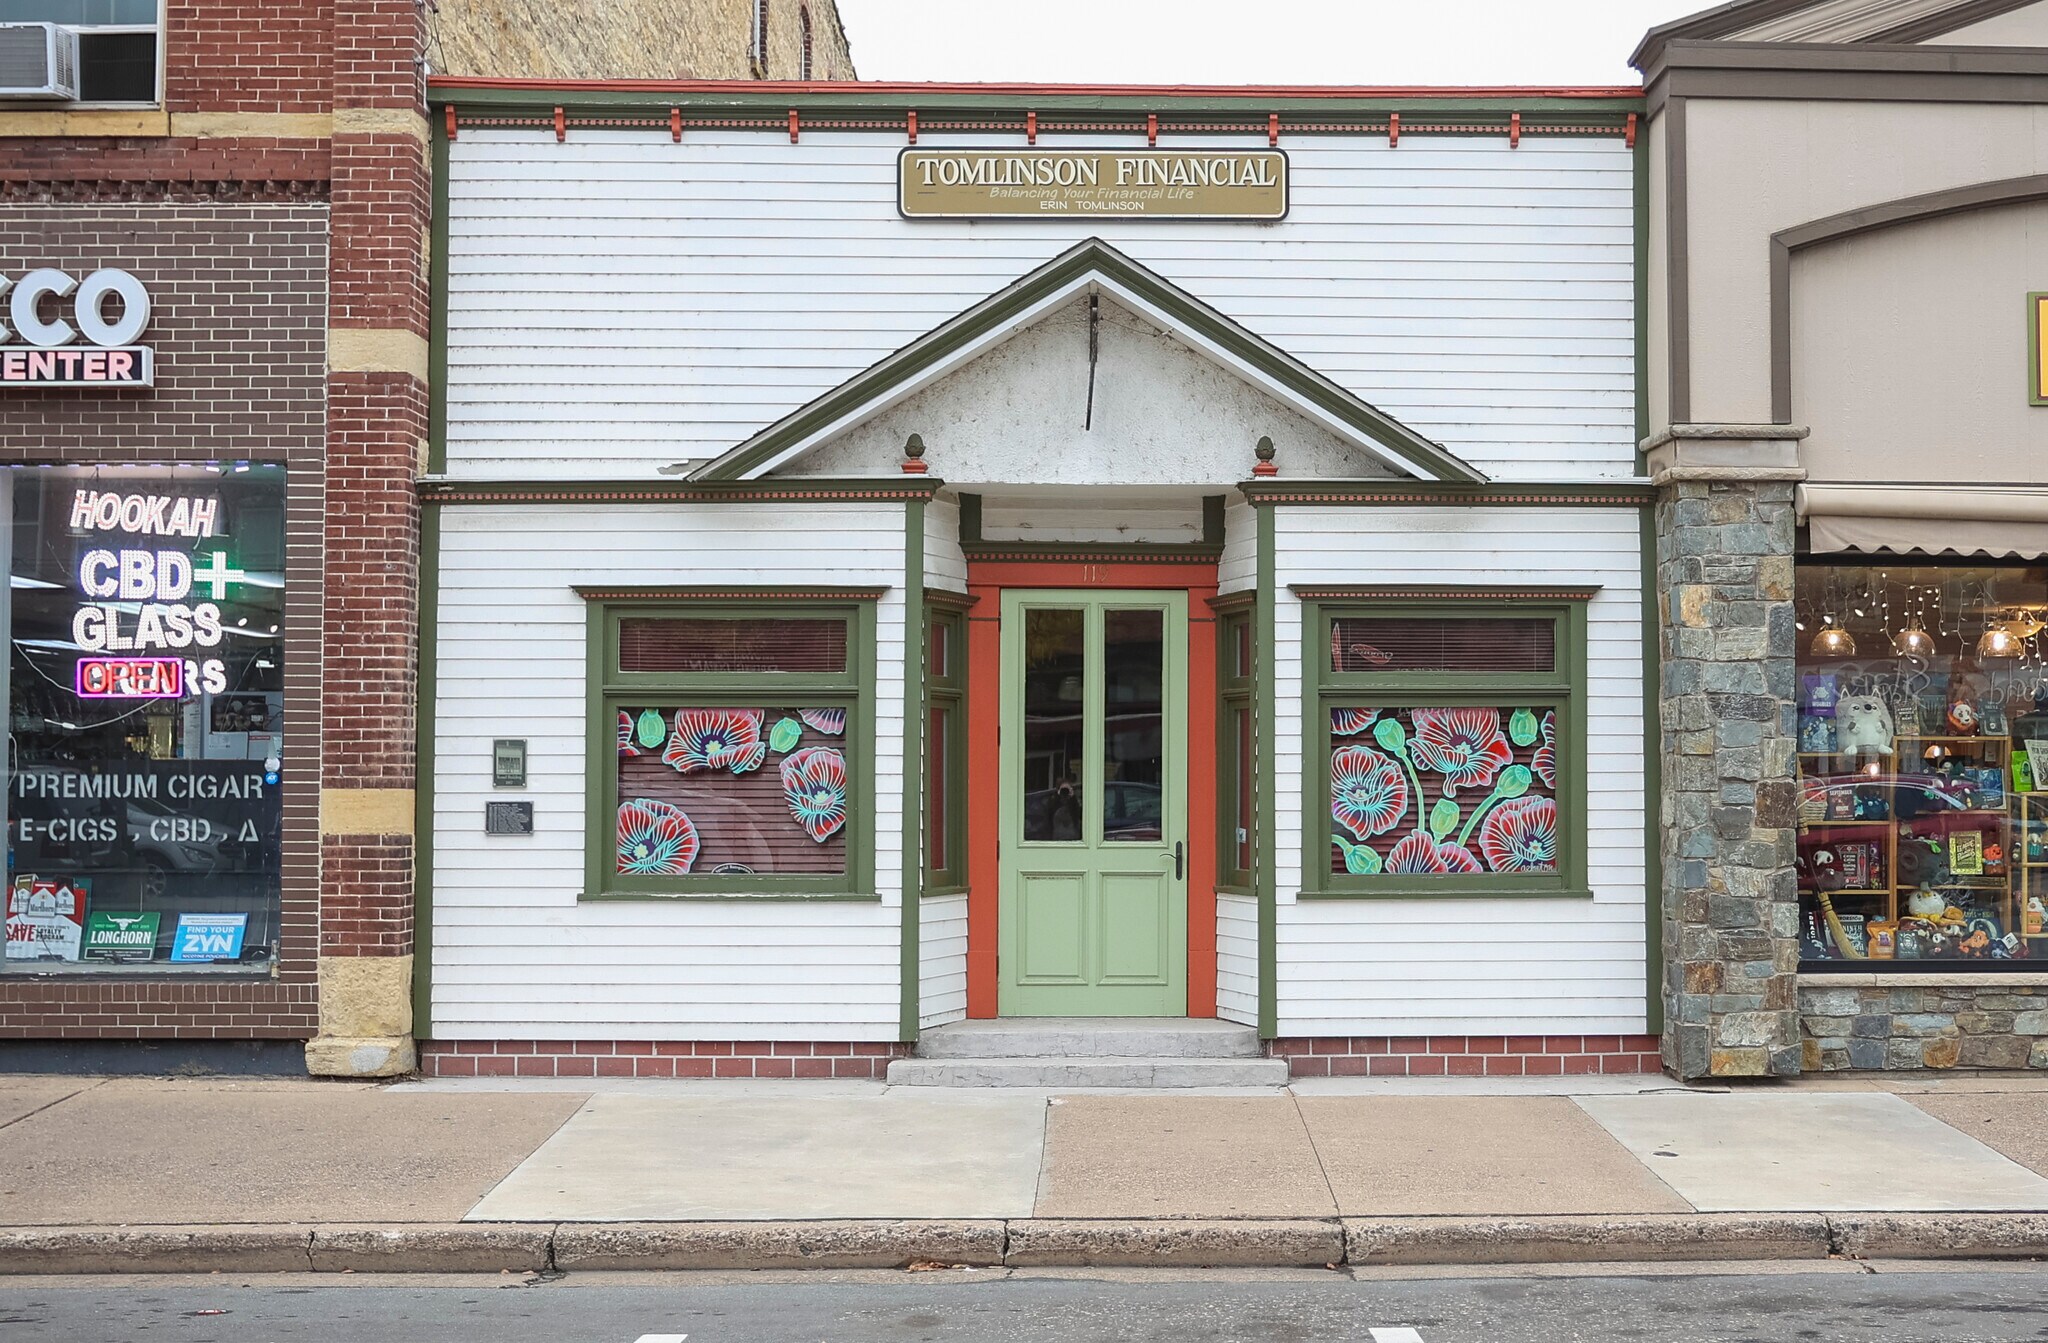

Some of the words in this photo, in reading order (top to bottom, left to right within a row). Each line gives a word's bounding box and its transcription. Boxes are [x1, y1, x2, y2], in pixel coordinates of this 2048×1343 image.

[916, 158, 1100, 186] TOMLINSON
[1115, 158, 1278, 187] FINANCIAL
[989, 187, 1058, 199] Balancing
[1064, 188, 1096, 199] Your
[1097, 188, 1164, 199] Financial
[1167, 188, 1194, 199] Life
[1040, 201, 1068, 210] ERIN
[1075, 201, 1145, 211] TOMLINSON
[0, 351, 133, 380] ENTER
[70, 489, 217, 537] HOOKAH
[72, 602, 222, 651] GLASS
[82, 661, 177, 694] OPEN
[19, 774, 158, 799] PREMIUM
[168, 774, 263, 799] CIGAR
[19, 818, 118, 842] E-CIGS
[150, 818, 211, 842] CBD
[6, 923, 36, 942] SAVE
[90, 930, 152, 944] LONGHORN
[183, 934, 234, 952] ZYN
